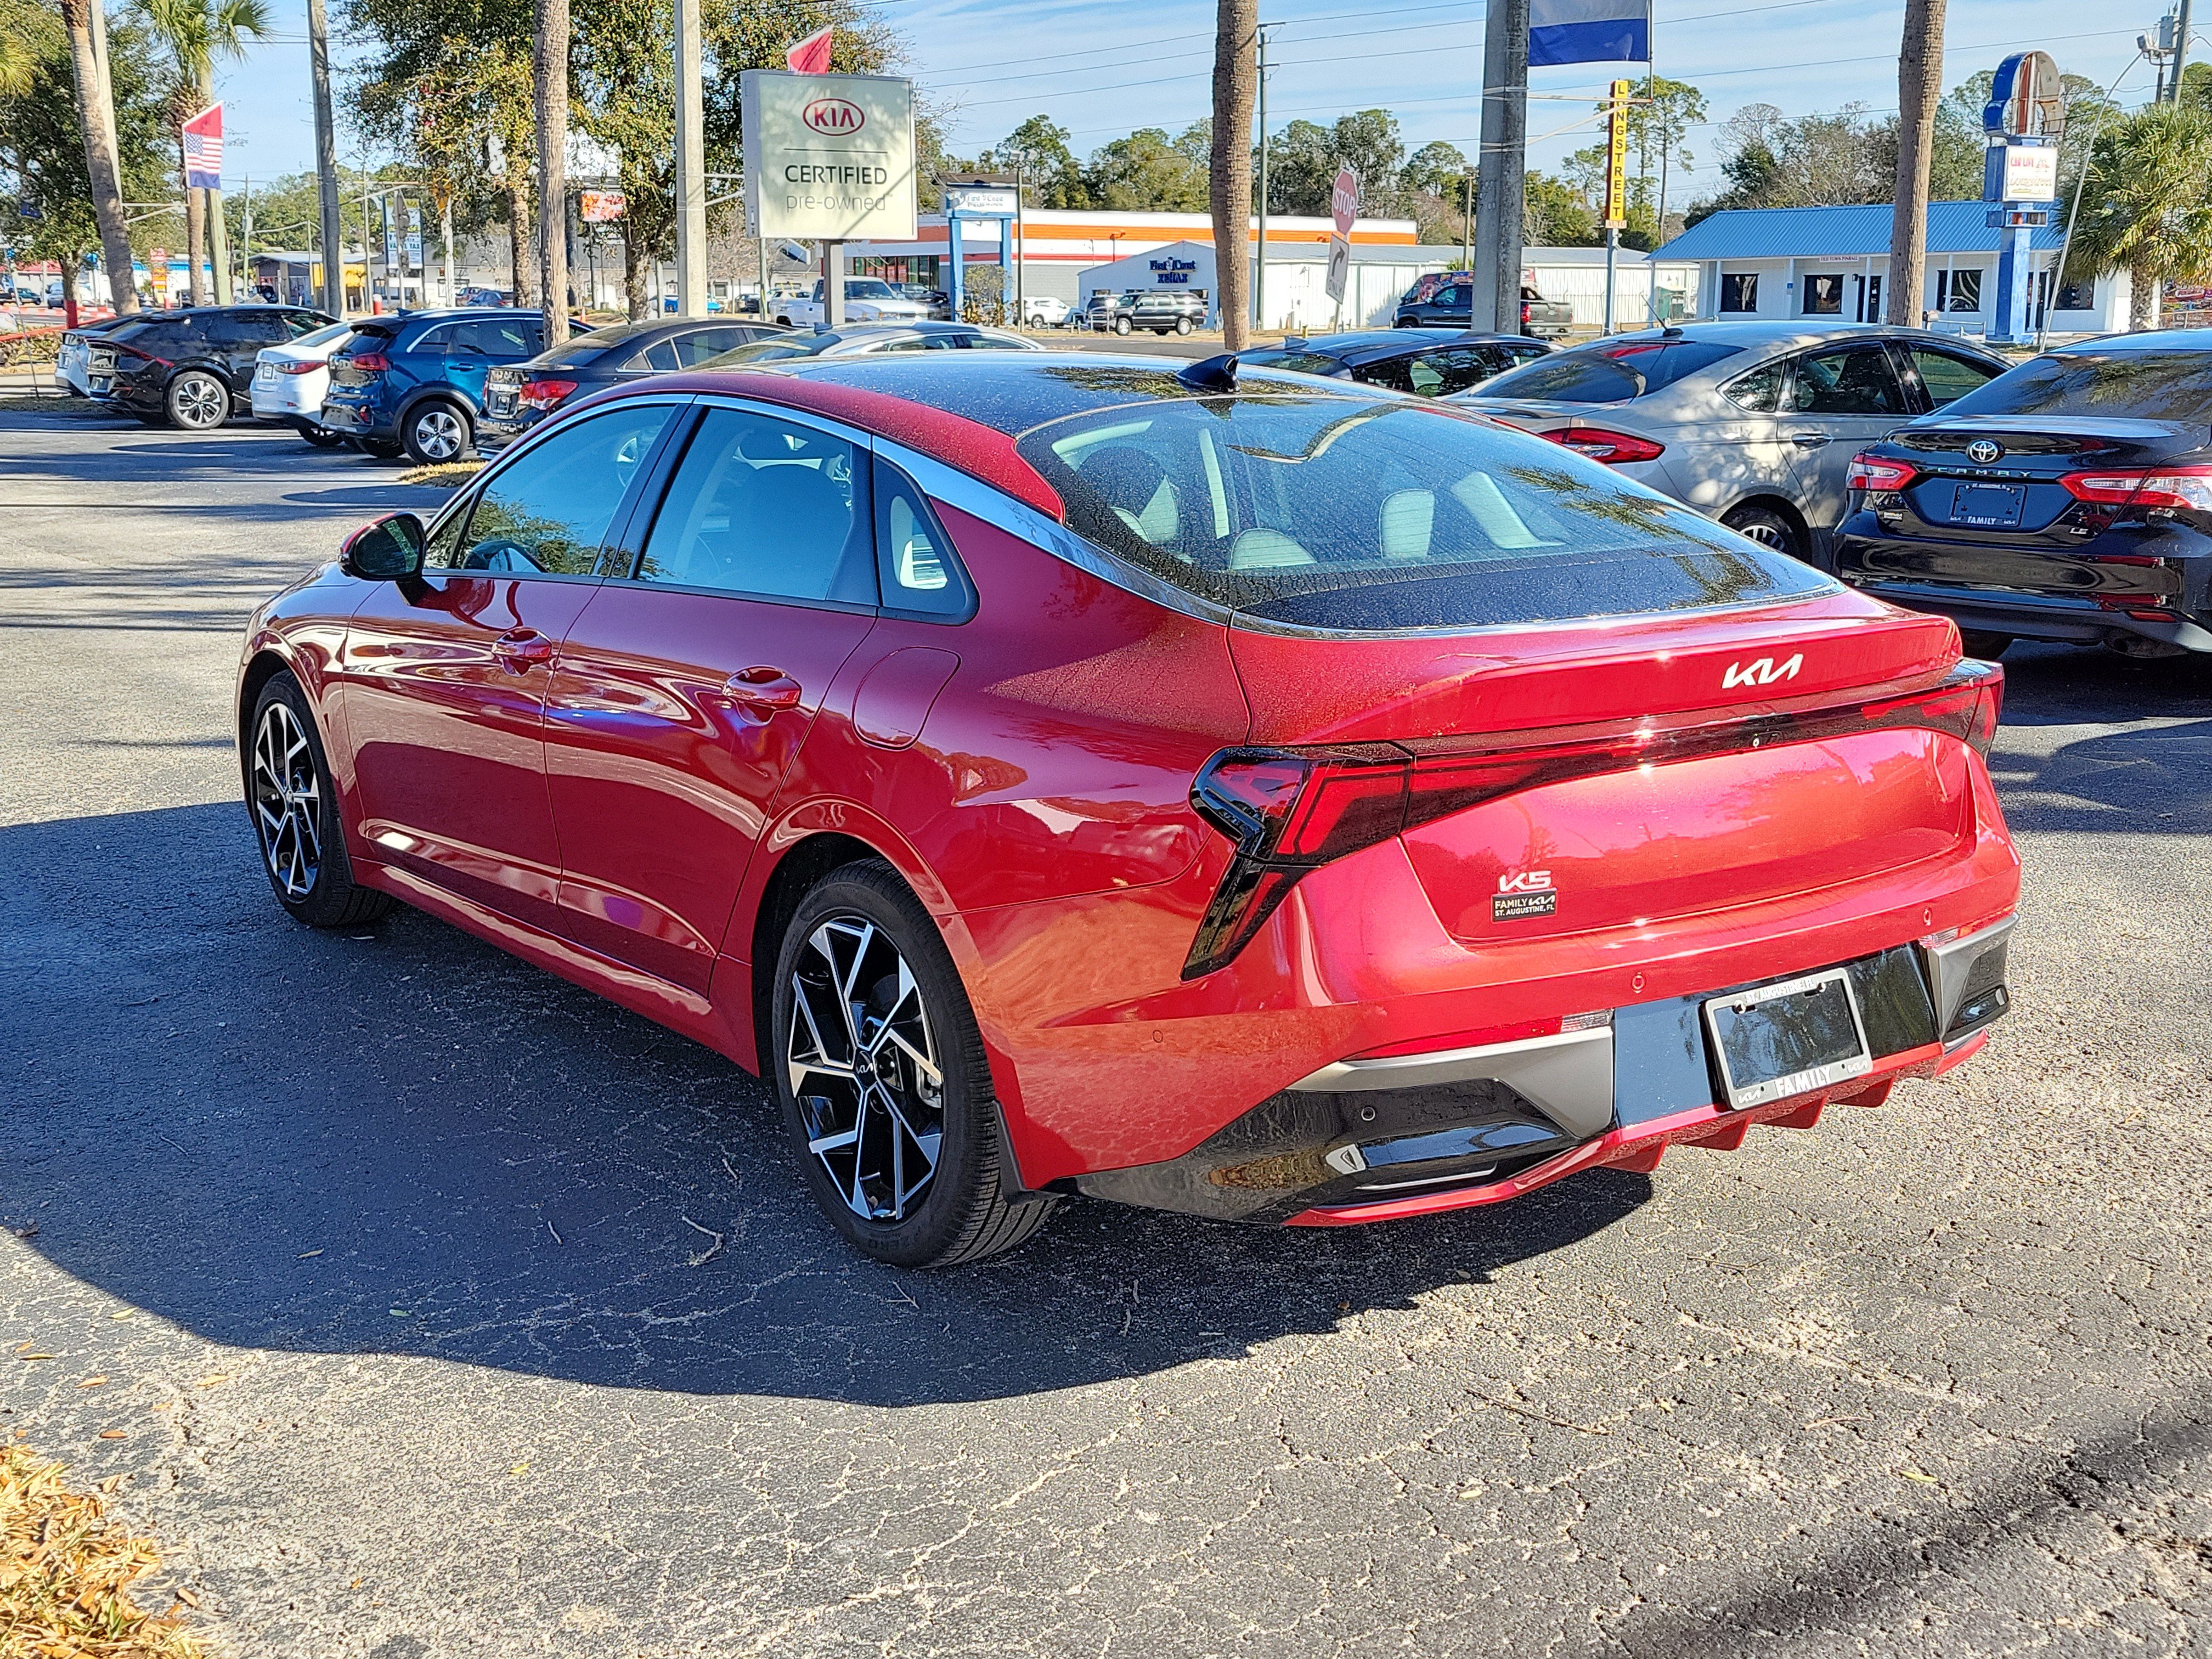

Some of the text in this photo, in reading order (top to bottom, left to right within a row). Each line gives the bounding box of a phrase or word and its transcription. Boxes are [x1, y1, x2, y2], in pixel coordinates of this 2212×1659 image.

[814, 107, 855, 127] KIA
[785, 165, 887, 184] CERTIFIED
[786, 195, 885, 213] pre-owned
[1334, 187, 1356, 218] STOP
[1328, 279, 1343, 296] ONLY
[1938, 467, 2031, 477] CAMRY
[1967, 516, 1996, 525] FAMILY
[1722, 653, 1804, 689] KIA
[1499, 870, 1551, 892] K5
[1495, 894, 1555, 909] FAMILY KIA
[1506, 905, 1546, 915] AUGUSTINE,
[1745, 992, 1758, 1003] ST.
[1805, 978, 1815, 988] FL
[1737, 1060, 1868, 1104] KIA FAMILY KIA
